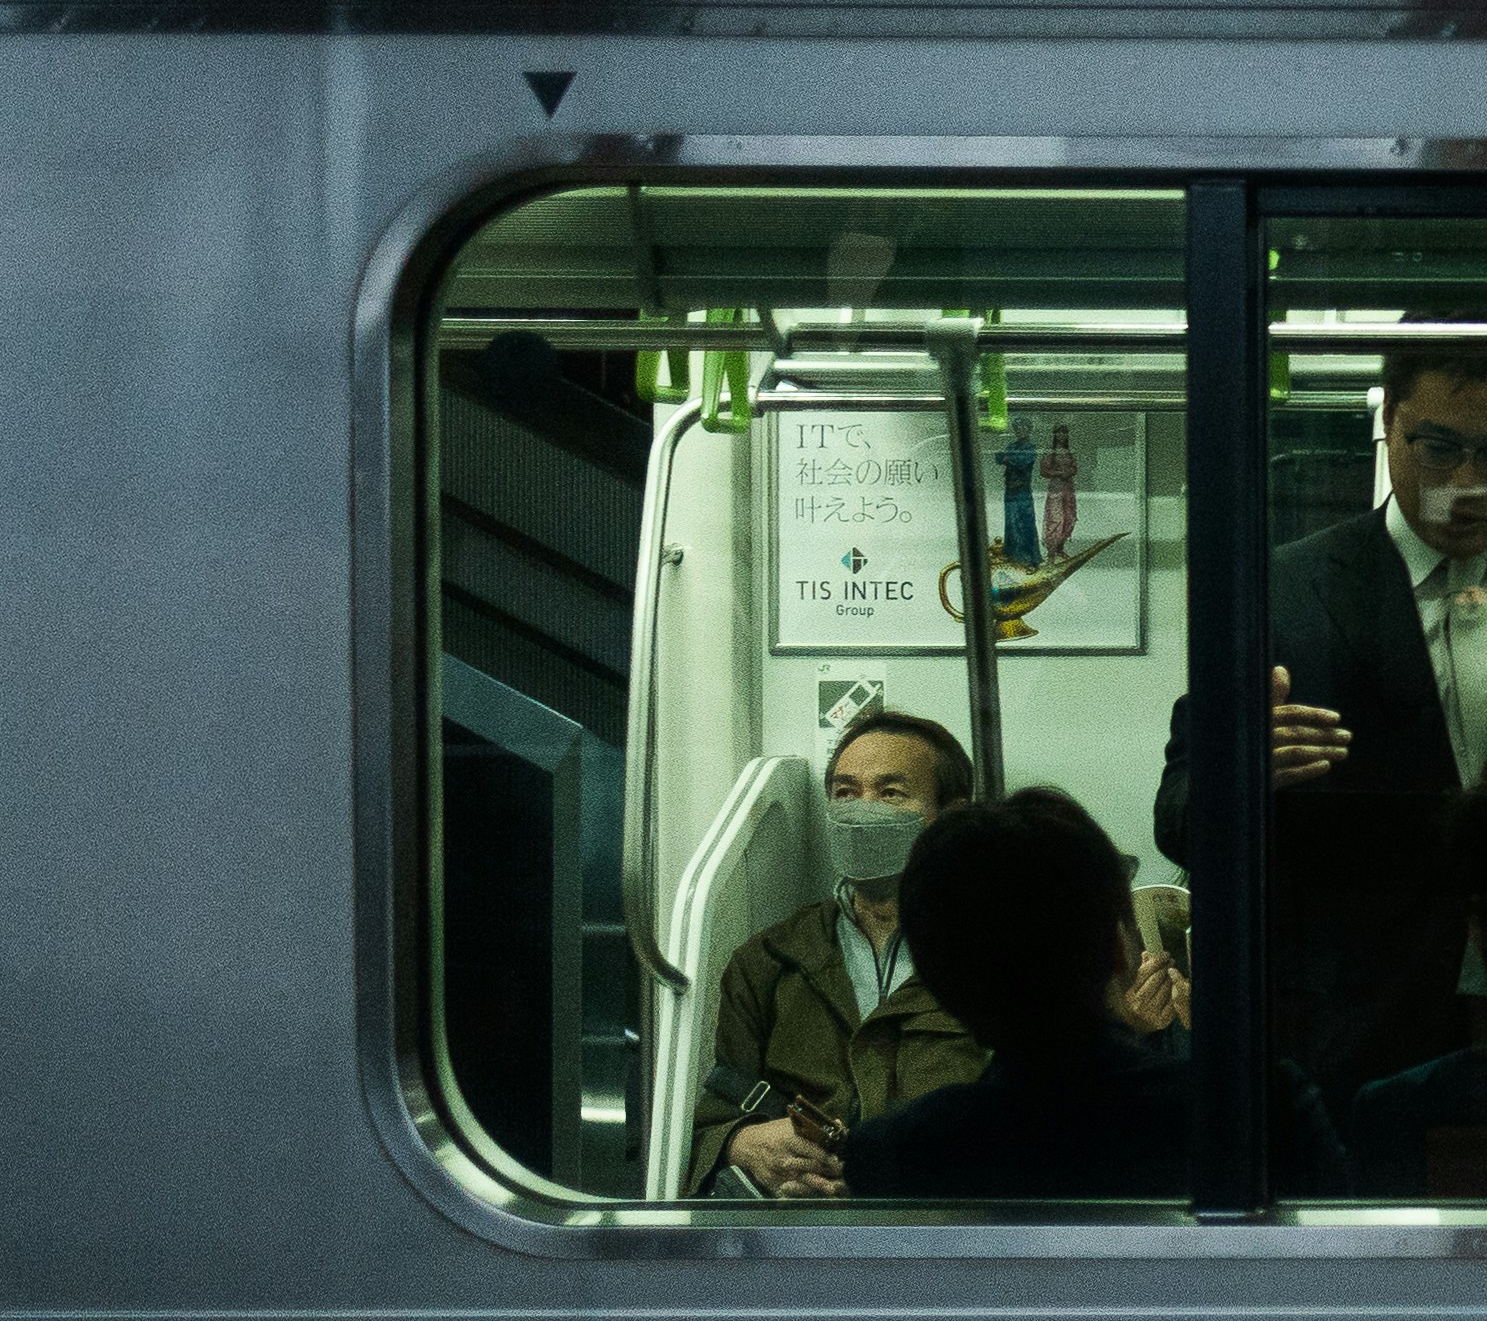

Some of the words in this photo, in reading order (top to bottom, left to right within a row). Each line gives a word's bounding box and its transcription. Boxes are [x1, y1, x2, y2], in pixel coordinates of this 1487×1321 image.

[795, 458, 939, 486] 社会の願い
[795, 495, 913, 524] 叶えよう。
[795, 580, 832, 601] TIS
[844, 580, 914, 601] INTEC
[835, 604, 875, 619] Group
